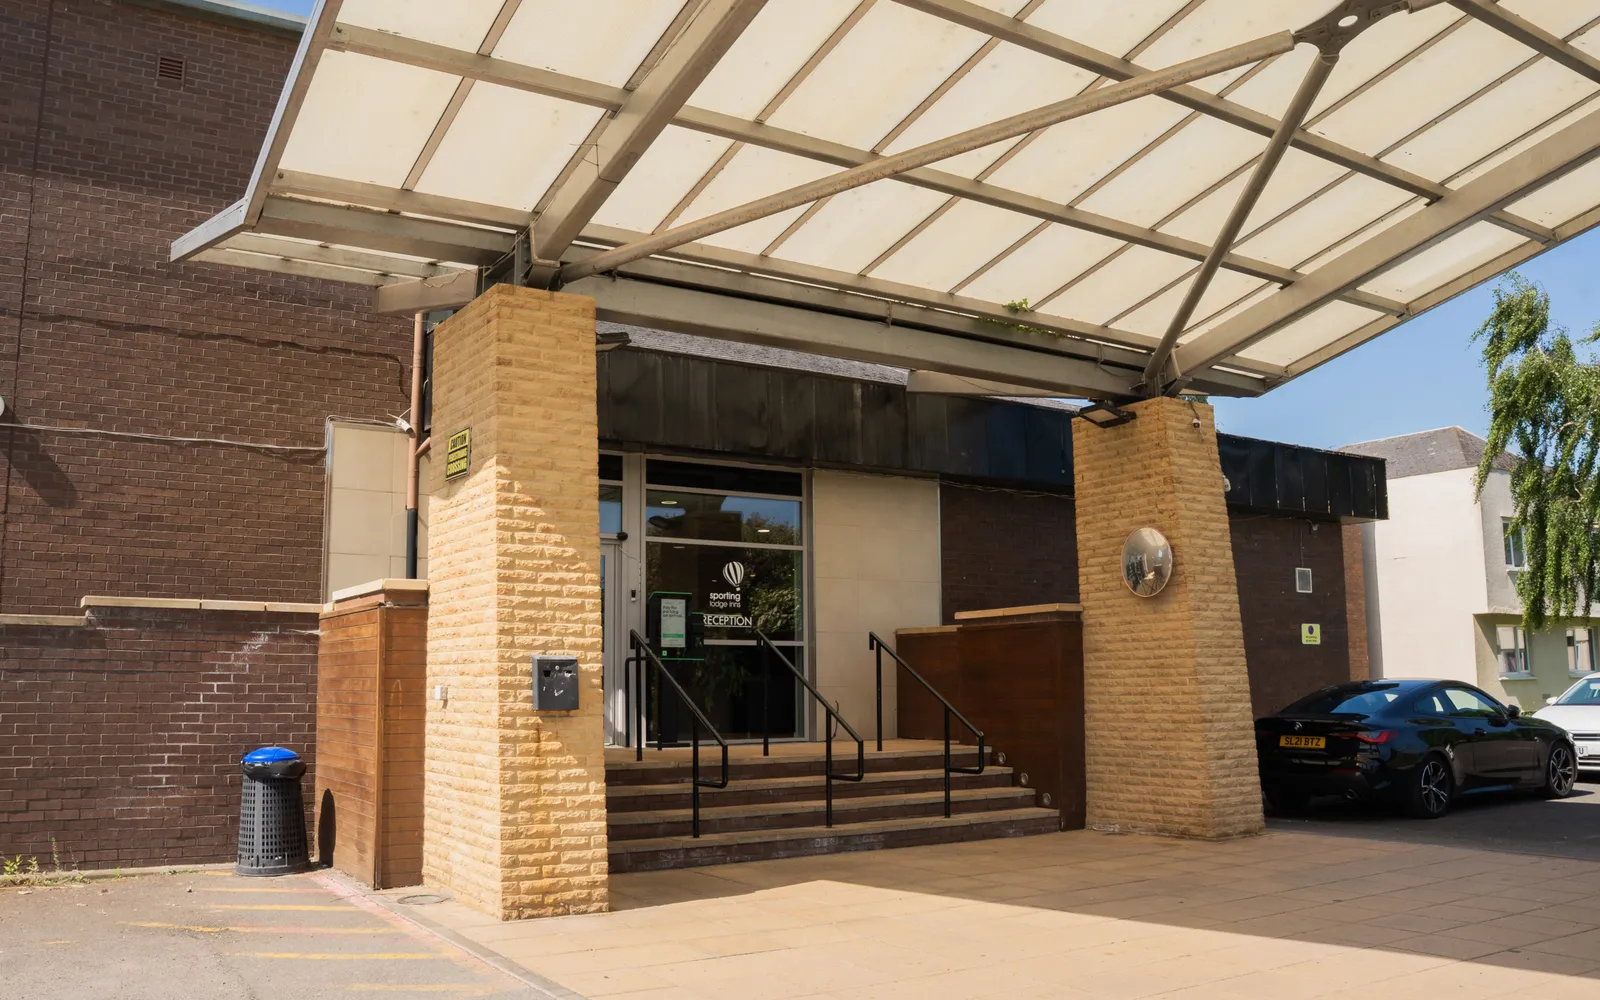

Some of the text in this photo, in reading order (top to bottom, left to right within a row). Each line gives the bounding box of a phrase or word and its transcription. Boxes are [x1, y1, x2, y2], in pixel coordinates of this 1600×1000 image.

[451, 433, 467, 450] CAUTION
[709, 592, 741, 602] sporting
[709, 601, 728, 609] lodge
[703, 615, 752, 626] RECEPTION
[1285, 736, 1321, 747] SL21 BTZ
